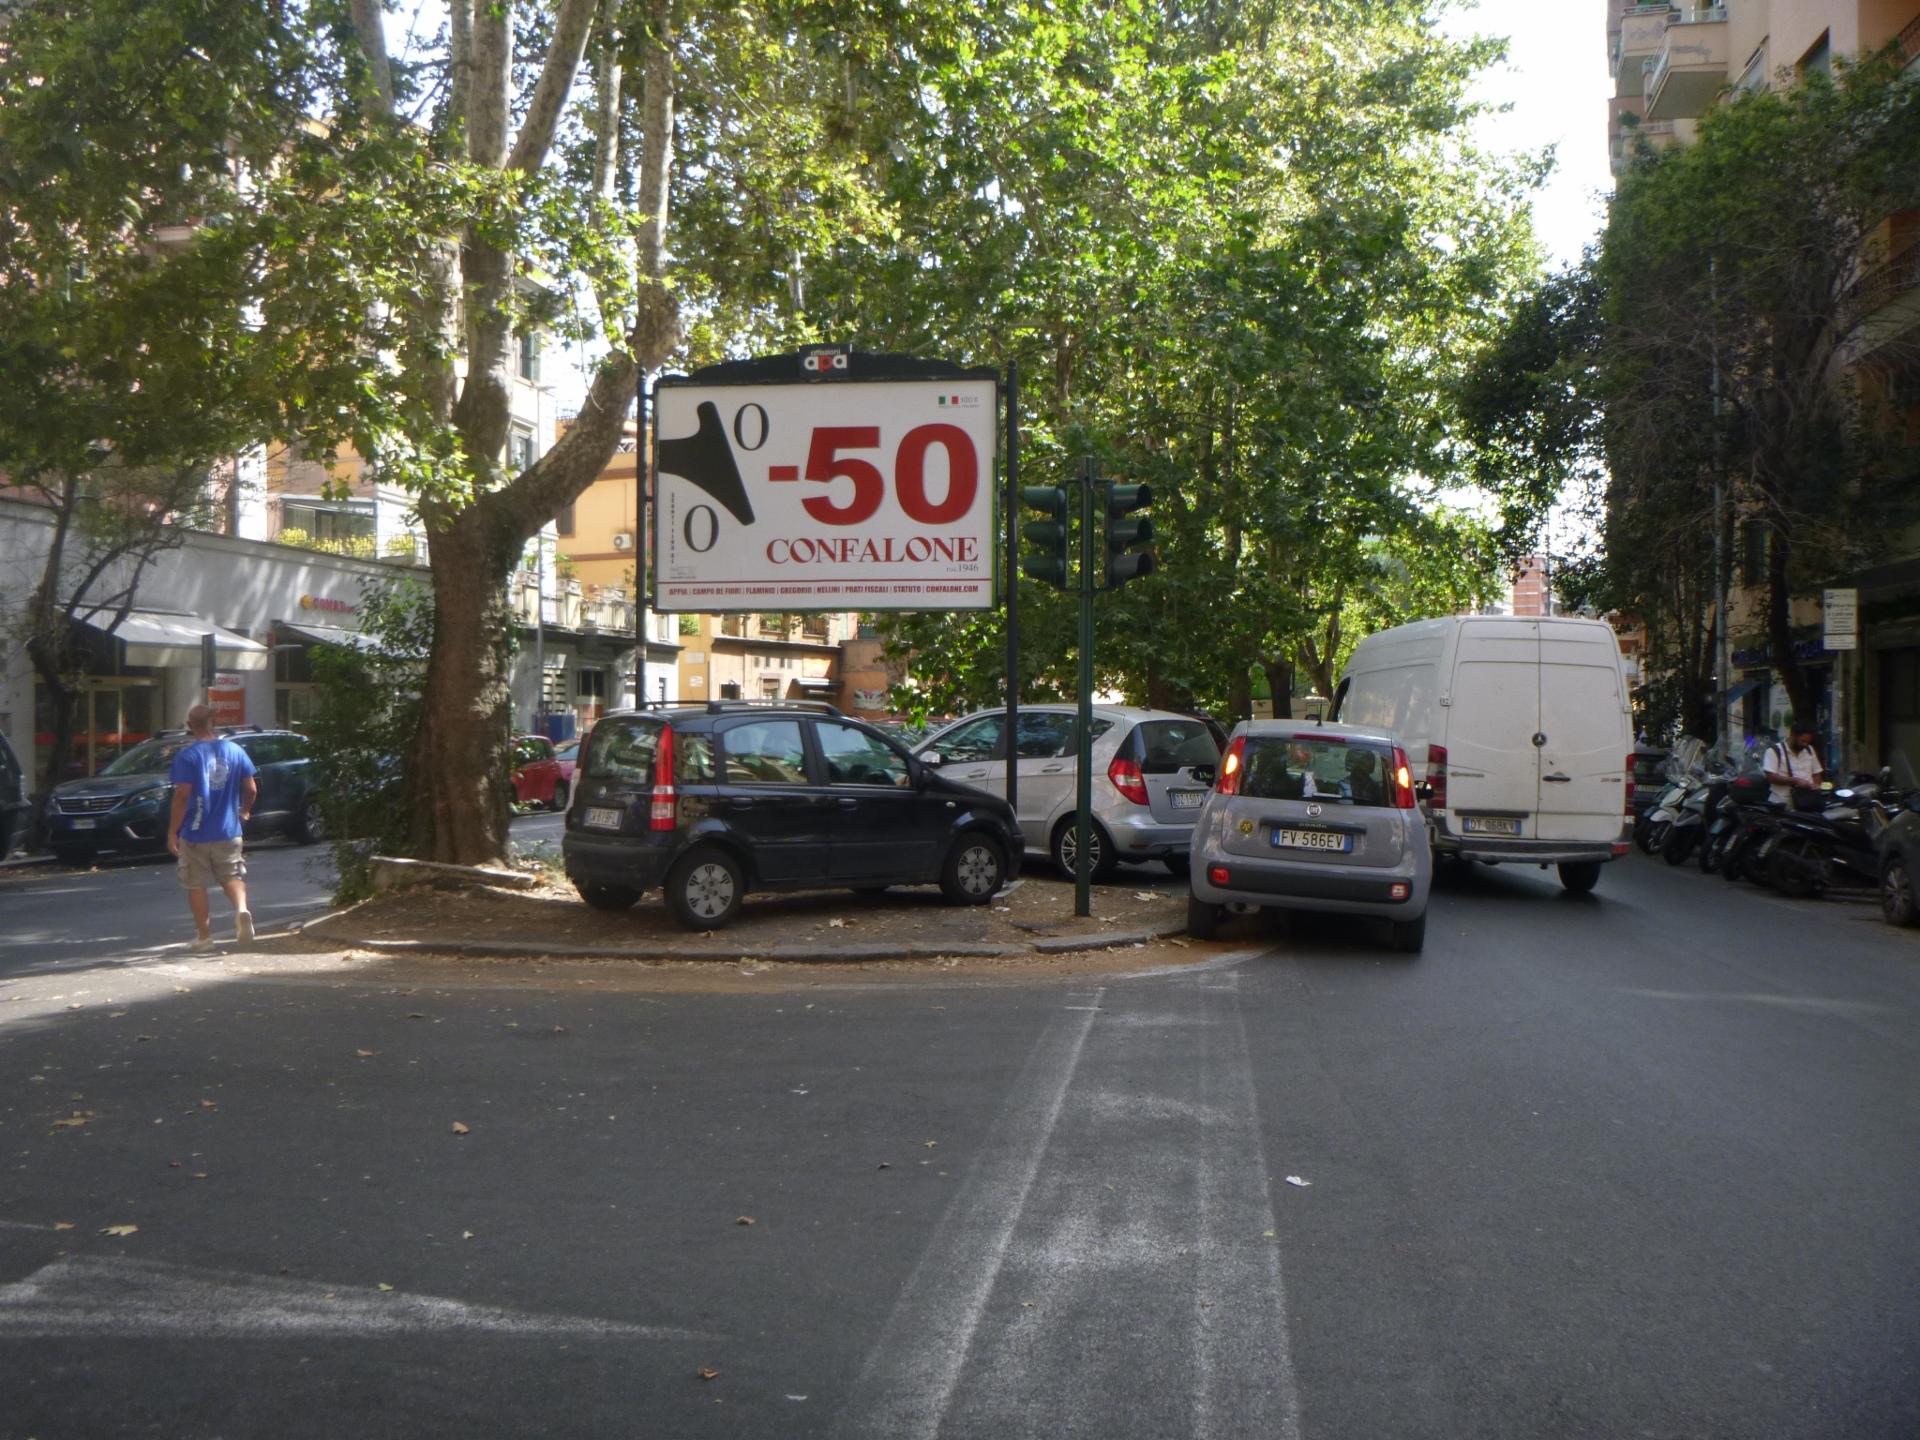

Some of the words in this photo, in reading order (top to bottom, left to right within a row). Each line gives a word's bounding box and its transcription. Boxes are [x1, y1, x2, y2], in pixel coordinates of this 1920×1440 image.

[766, 536, 979, 565] CONFALONE
[958, 563, 979, 573] 1946
[693, 587, 714, 595] CAMPO
[845, 585, 863, 593] PRATI
[865, 585, 889, 593] FISCALI
[893, 584, 921, 593] STATUTO
[926, 584, 979, 593] CONFALONE.COM
[1281, 830, 1297, 845] FV
[1302, 832, 1343, 849] 586EV
